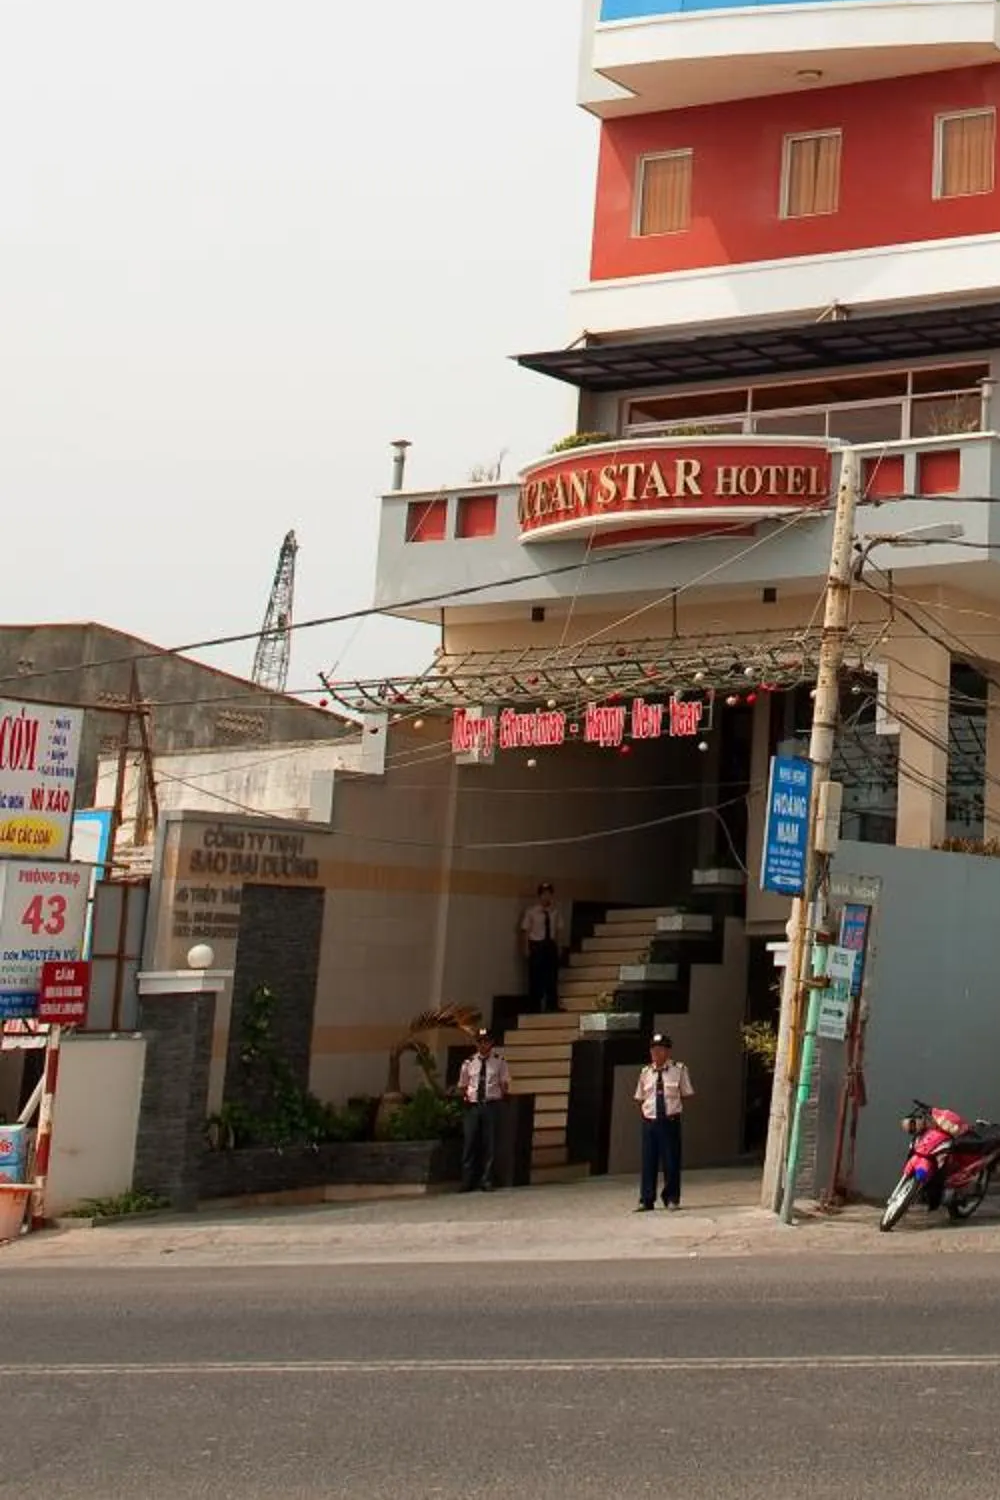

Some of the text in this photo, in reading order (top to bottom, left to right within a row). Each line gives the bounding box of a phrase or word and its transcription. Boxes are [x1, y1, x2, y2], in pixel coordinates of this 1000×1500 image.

[597, 458, 702, 503] STAR
[714, 464, 827, 497] HOTEL
[451, 708, 494, 756] Merry
[500, 708, 566, 749] Christmas
[584, 703, 625, 748] Happy
[631, 698, 664, 739] New
[669, 696, 702, 736] Year
[21, 894, 67, 935] 43
